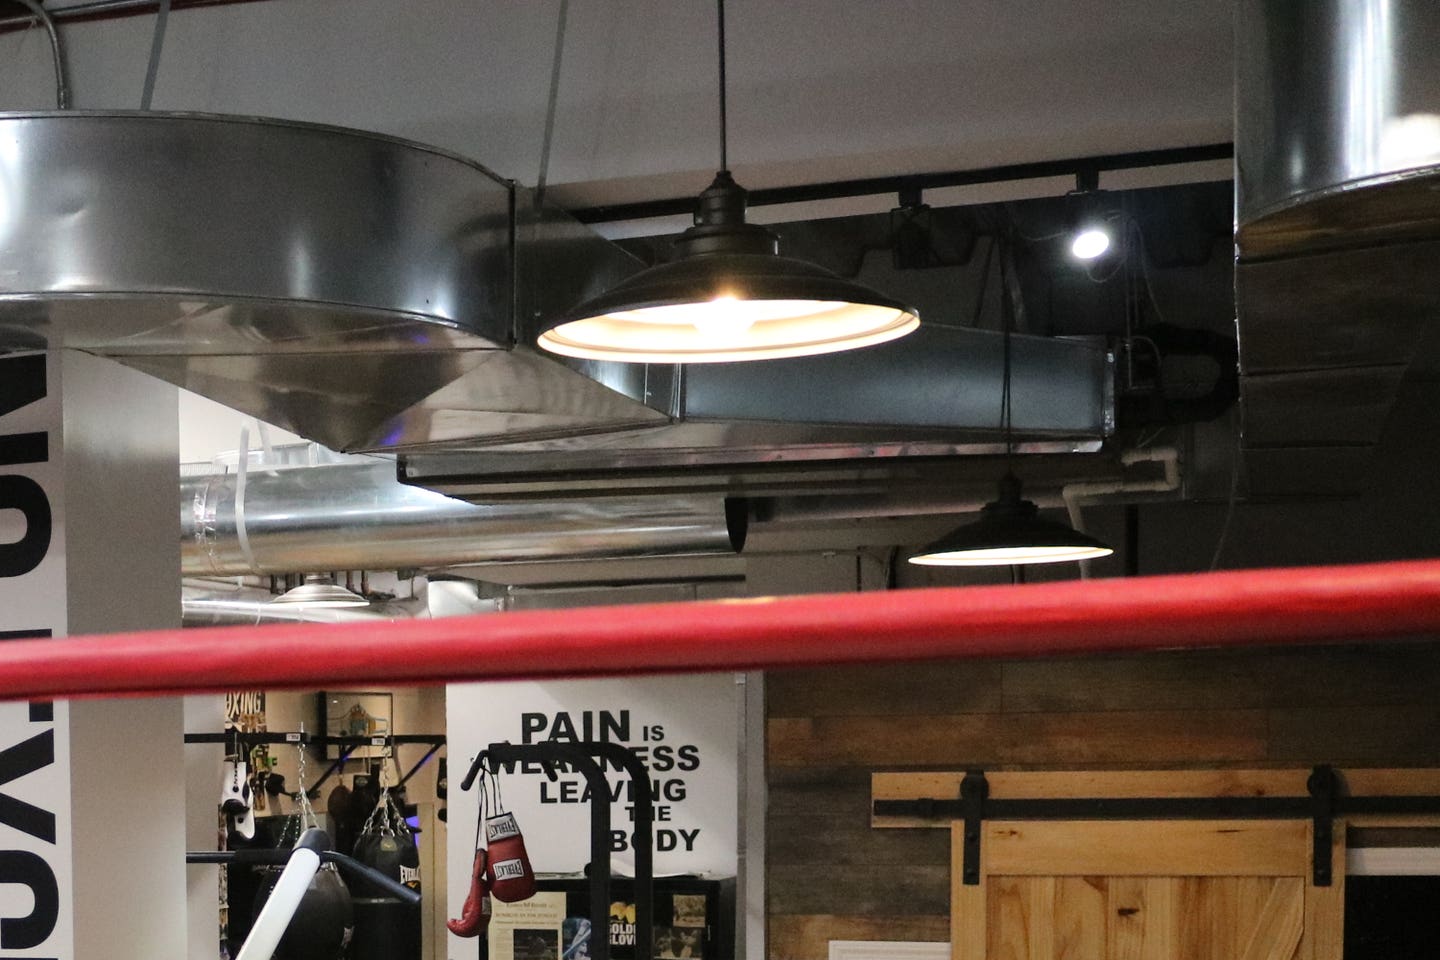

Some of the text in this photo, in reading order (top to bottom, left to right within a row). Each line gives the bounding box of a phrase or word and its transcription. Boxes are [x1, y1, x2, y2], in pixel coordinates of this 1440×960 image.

[521, 710, 665, 744] PAIN IS
[625, 806, 671, 821] TE
[611, 829, 701, 852] BDY
[610, 924, 636, 934] OLD
[610, 935, 636, 945] LOV
